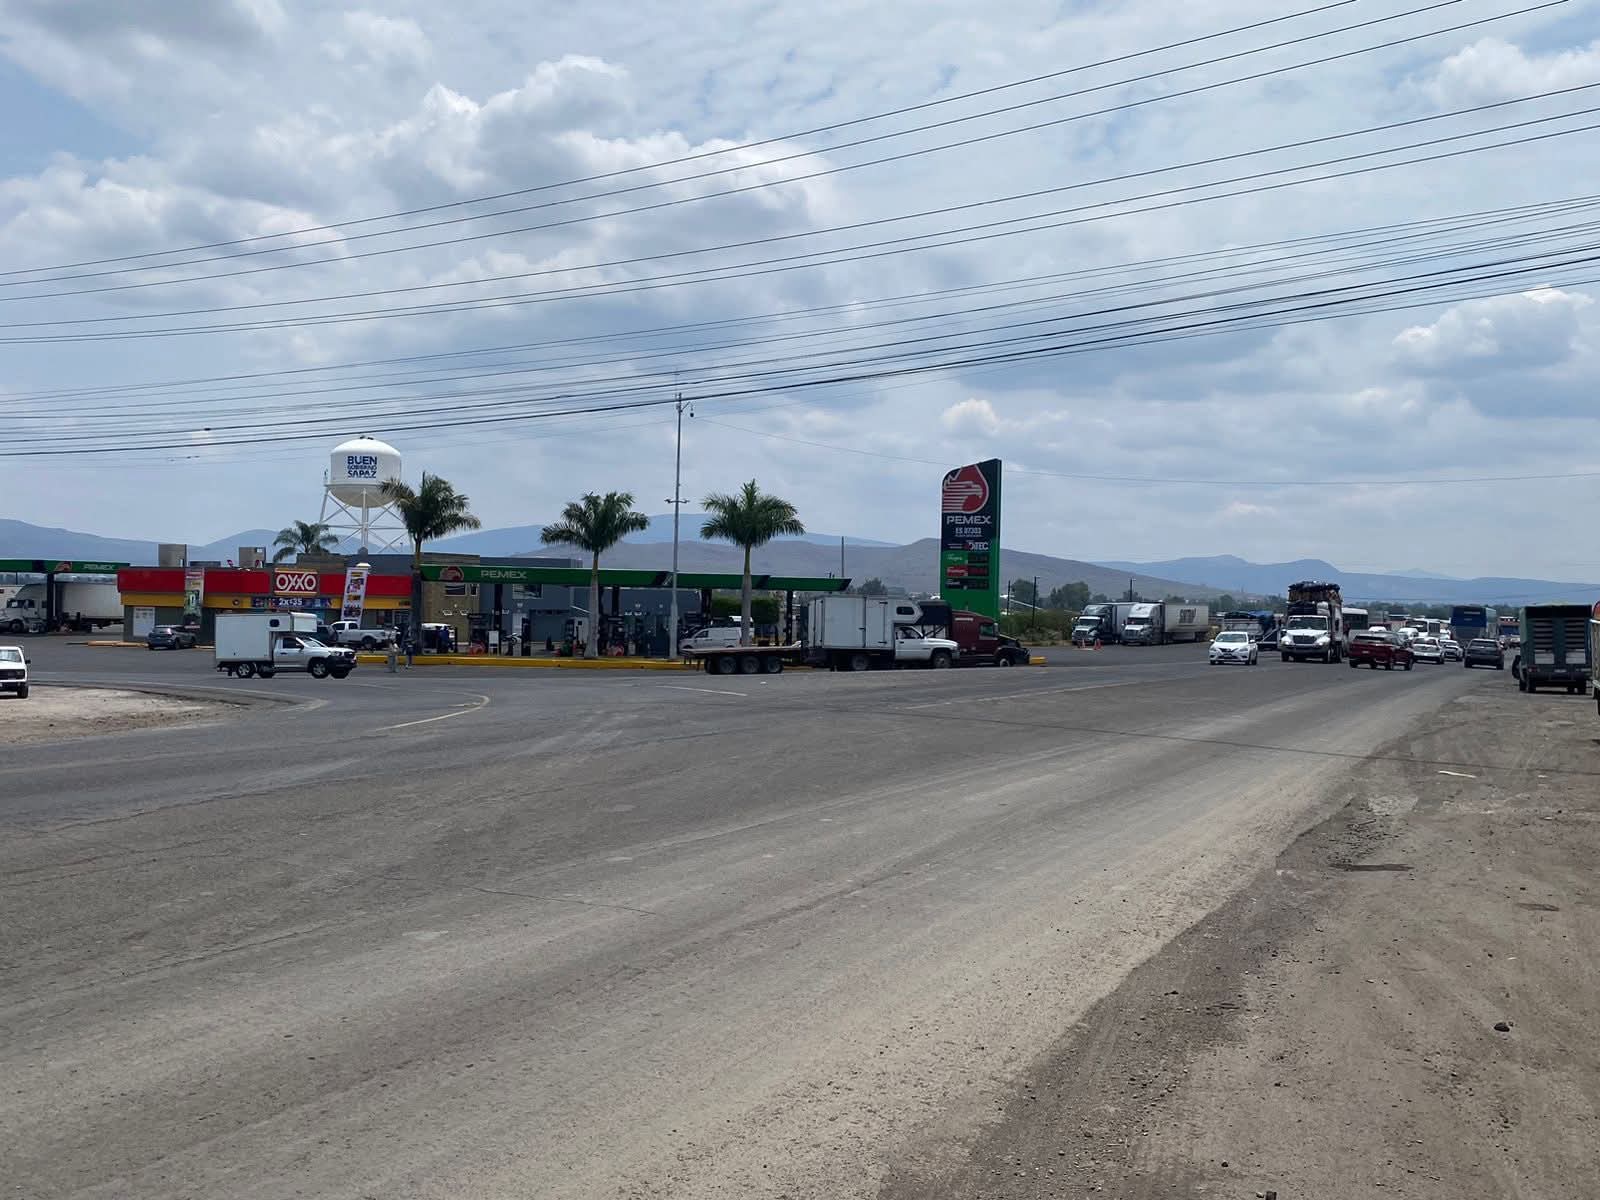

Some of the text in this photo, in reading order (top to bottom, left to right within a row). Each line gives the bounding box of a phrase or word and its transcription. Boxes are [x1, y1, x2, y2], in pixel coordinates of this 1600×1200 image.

[347, 455, 378, 465] BUEN
[347, 470, 378, 479] SAPAZ
[946, 515, 992, 525] PEMEX
[481, 570, 527, 579] PEMEX
[276, 573, 317, 592] OXXO
